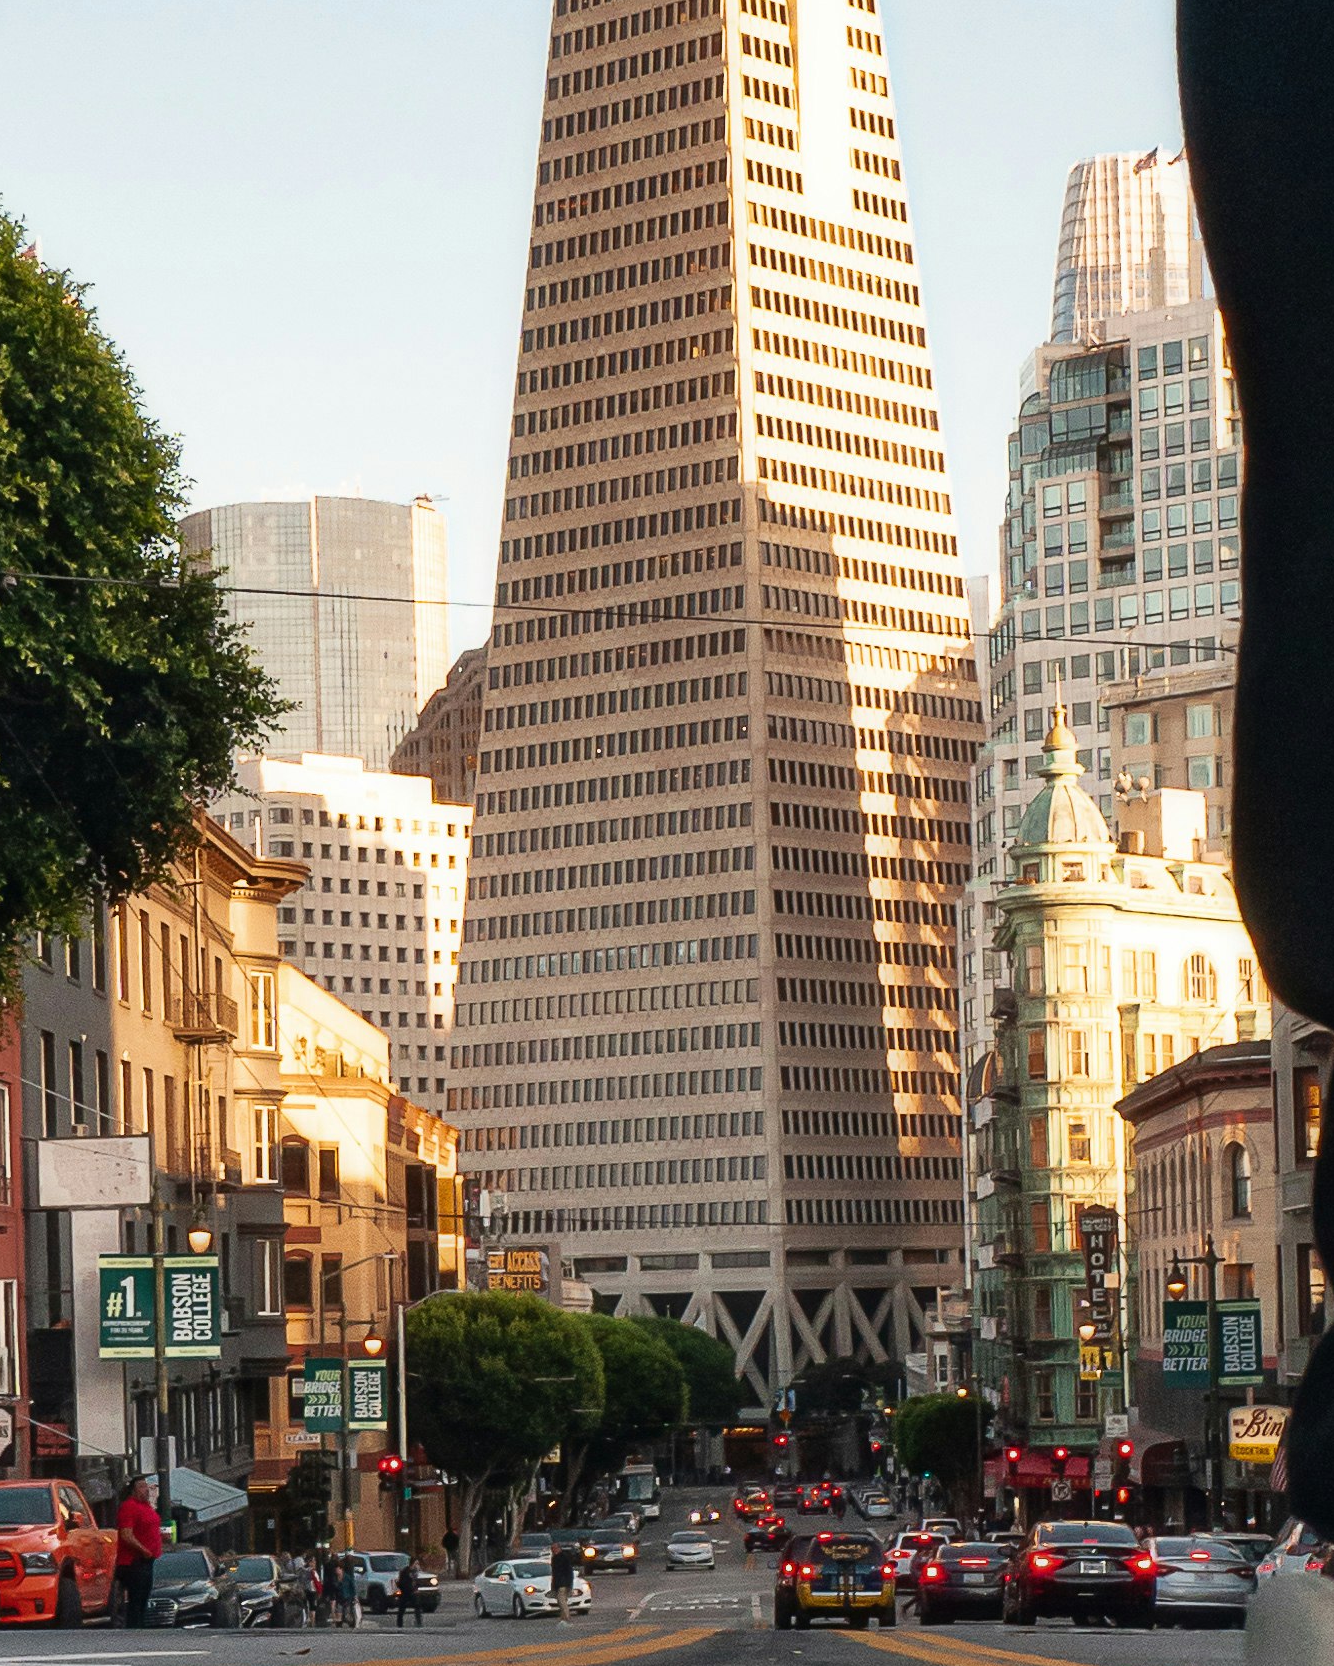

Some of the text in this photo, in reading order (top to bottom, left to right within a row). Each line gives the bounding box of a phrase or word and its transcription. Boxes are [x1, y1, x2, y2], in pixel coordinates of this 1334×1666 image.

[1090, 1234, 1108, 1320] HOTEL
[171, 1273, 192, 1341] BABSON
[191, 1272, 212, 1341] COLLEGE
[1176, 1314, 1208, 1328] YOUR
[1163, 1328, 1208, 1343] BRIDGE
[1239, 1314, 1257, 1372] COLLEGE
[1193, 1343, 1208, 1356] TO
[1222, 1315, 1240, 1372] BABSON
[1163, 1357, 1208, 1371] BETTER
[315, 1370, 342, 1382] YOUR
[304, 1381, 342, 1393] BRIDGE
[353, 1370, 368, 1419] BABSON
[367, 1370, 382, 1419] COLLEGE
[329, 1393, 342, 1405] TO
[304, 1405, 342, 1418] BETTER
